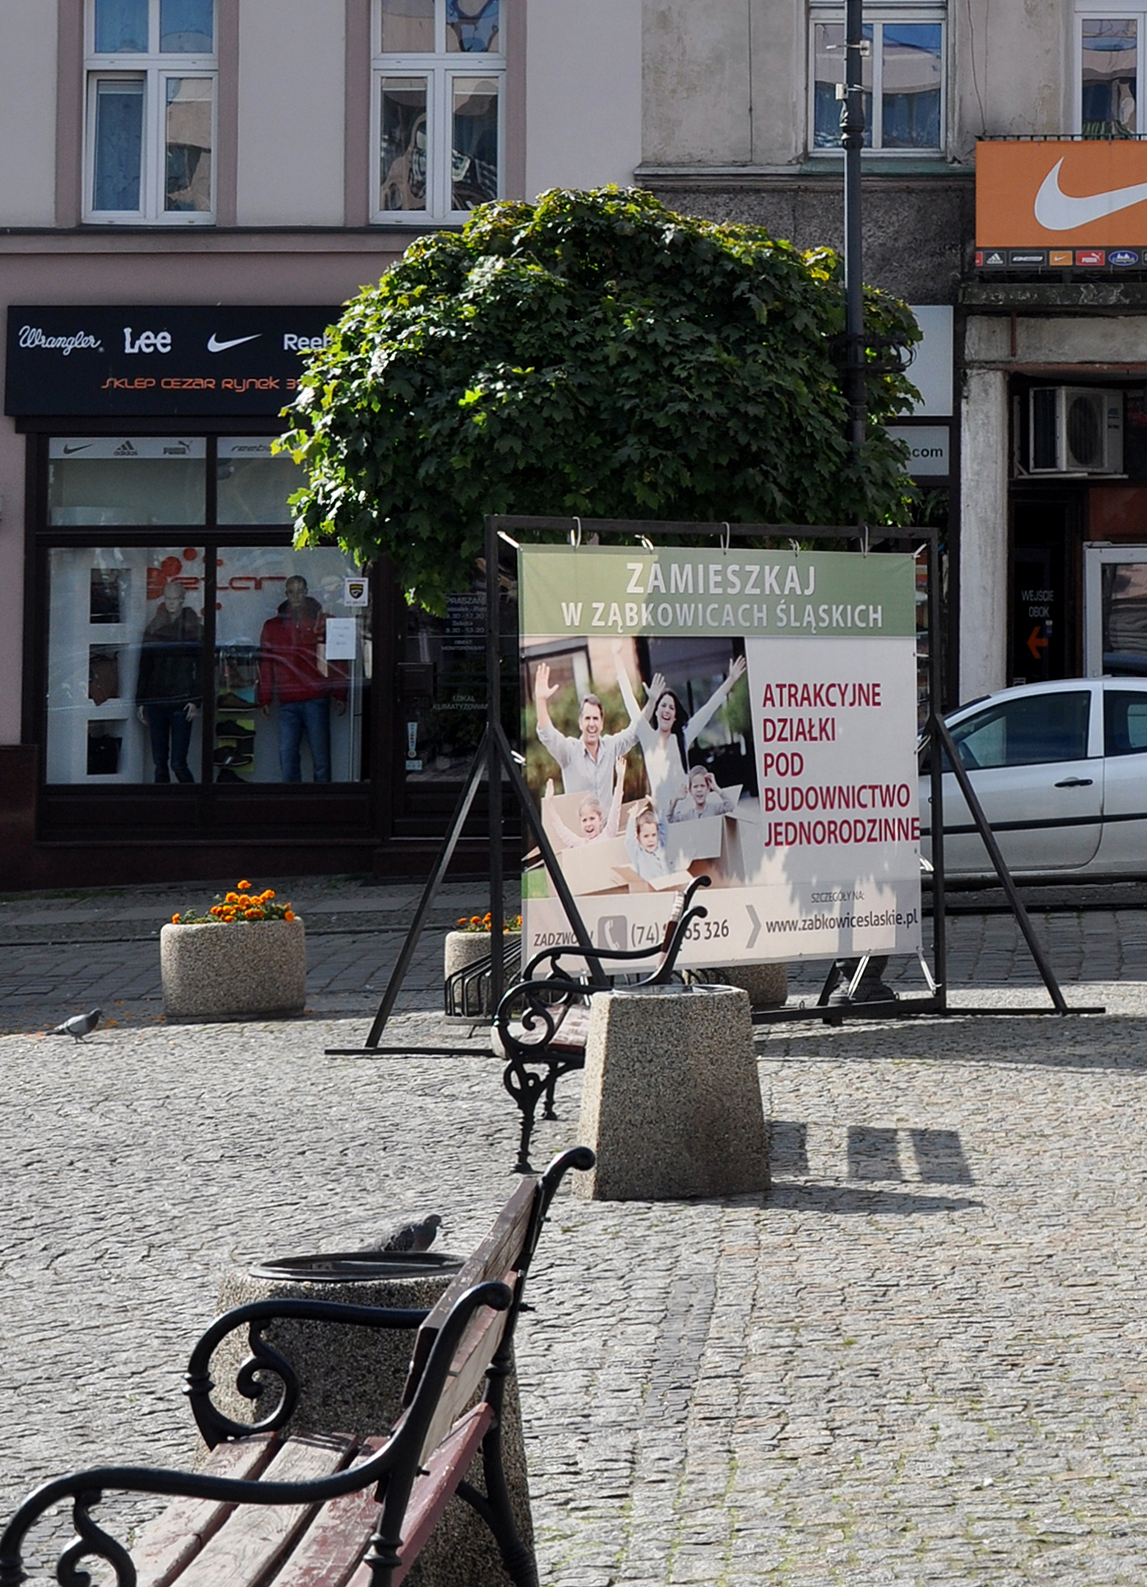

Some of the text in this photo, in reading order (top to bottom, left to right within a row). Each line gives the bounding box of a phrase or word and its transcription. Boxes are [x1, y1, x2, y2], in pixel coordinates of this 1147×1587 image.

[18, 325, 101, 356] Wrangler
[123, 327, 172, 354] Lee
[283, 332, 334, 351] Reeb
[101, 377, 156, 390] SKLEP
[161, 377, 216, 390] CEZAR
[231, 444, 272, 452] reebo
[626, 562, 816, 597] ZAMIESZKAJ
[1021, 587, 1055, 602] WEJŚCIE
[561, 599, 883, 634] W ZĄBKOWICACH ŚLĄSKICH
[1028, 605, 1051, 618] OBOK
[763, 683, 882, 708] ATRAKCYJNE
[763, 717, 836, 742] DZIAŁKI
[764, 752, 804, 777] POD
[764, 783, 911, 812] BUDOWNICTWO
[765, 817, 921, 847] JEDNORODZINNE
[811, 890, 865, 904] SZCZEGÓŁY NA:
[765, 908, 919, 933] www.zabkowiceslaskie.pl
[631, 922, 660, 948] (74)
[704, 919, 730, 941] 326
